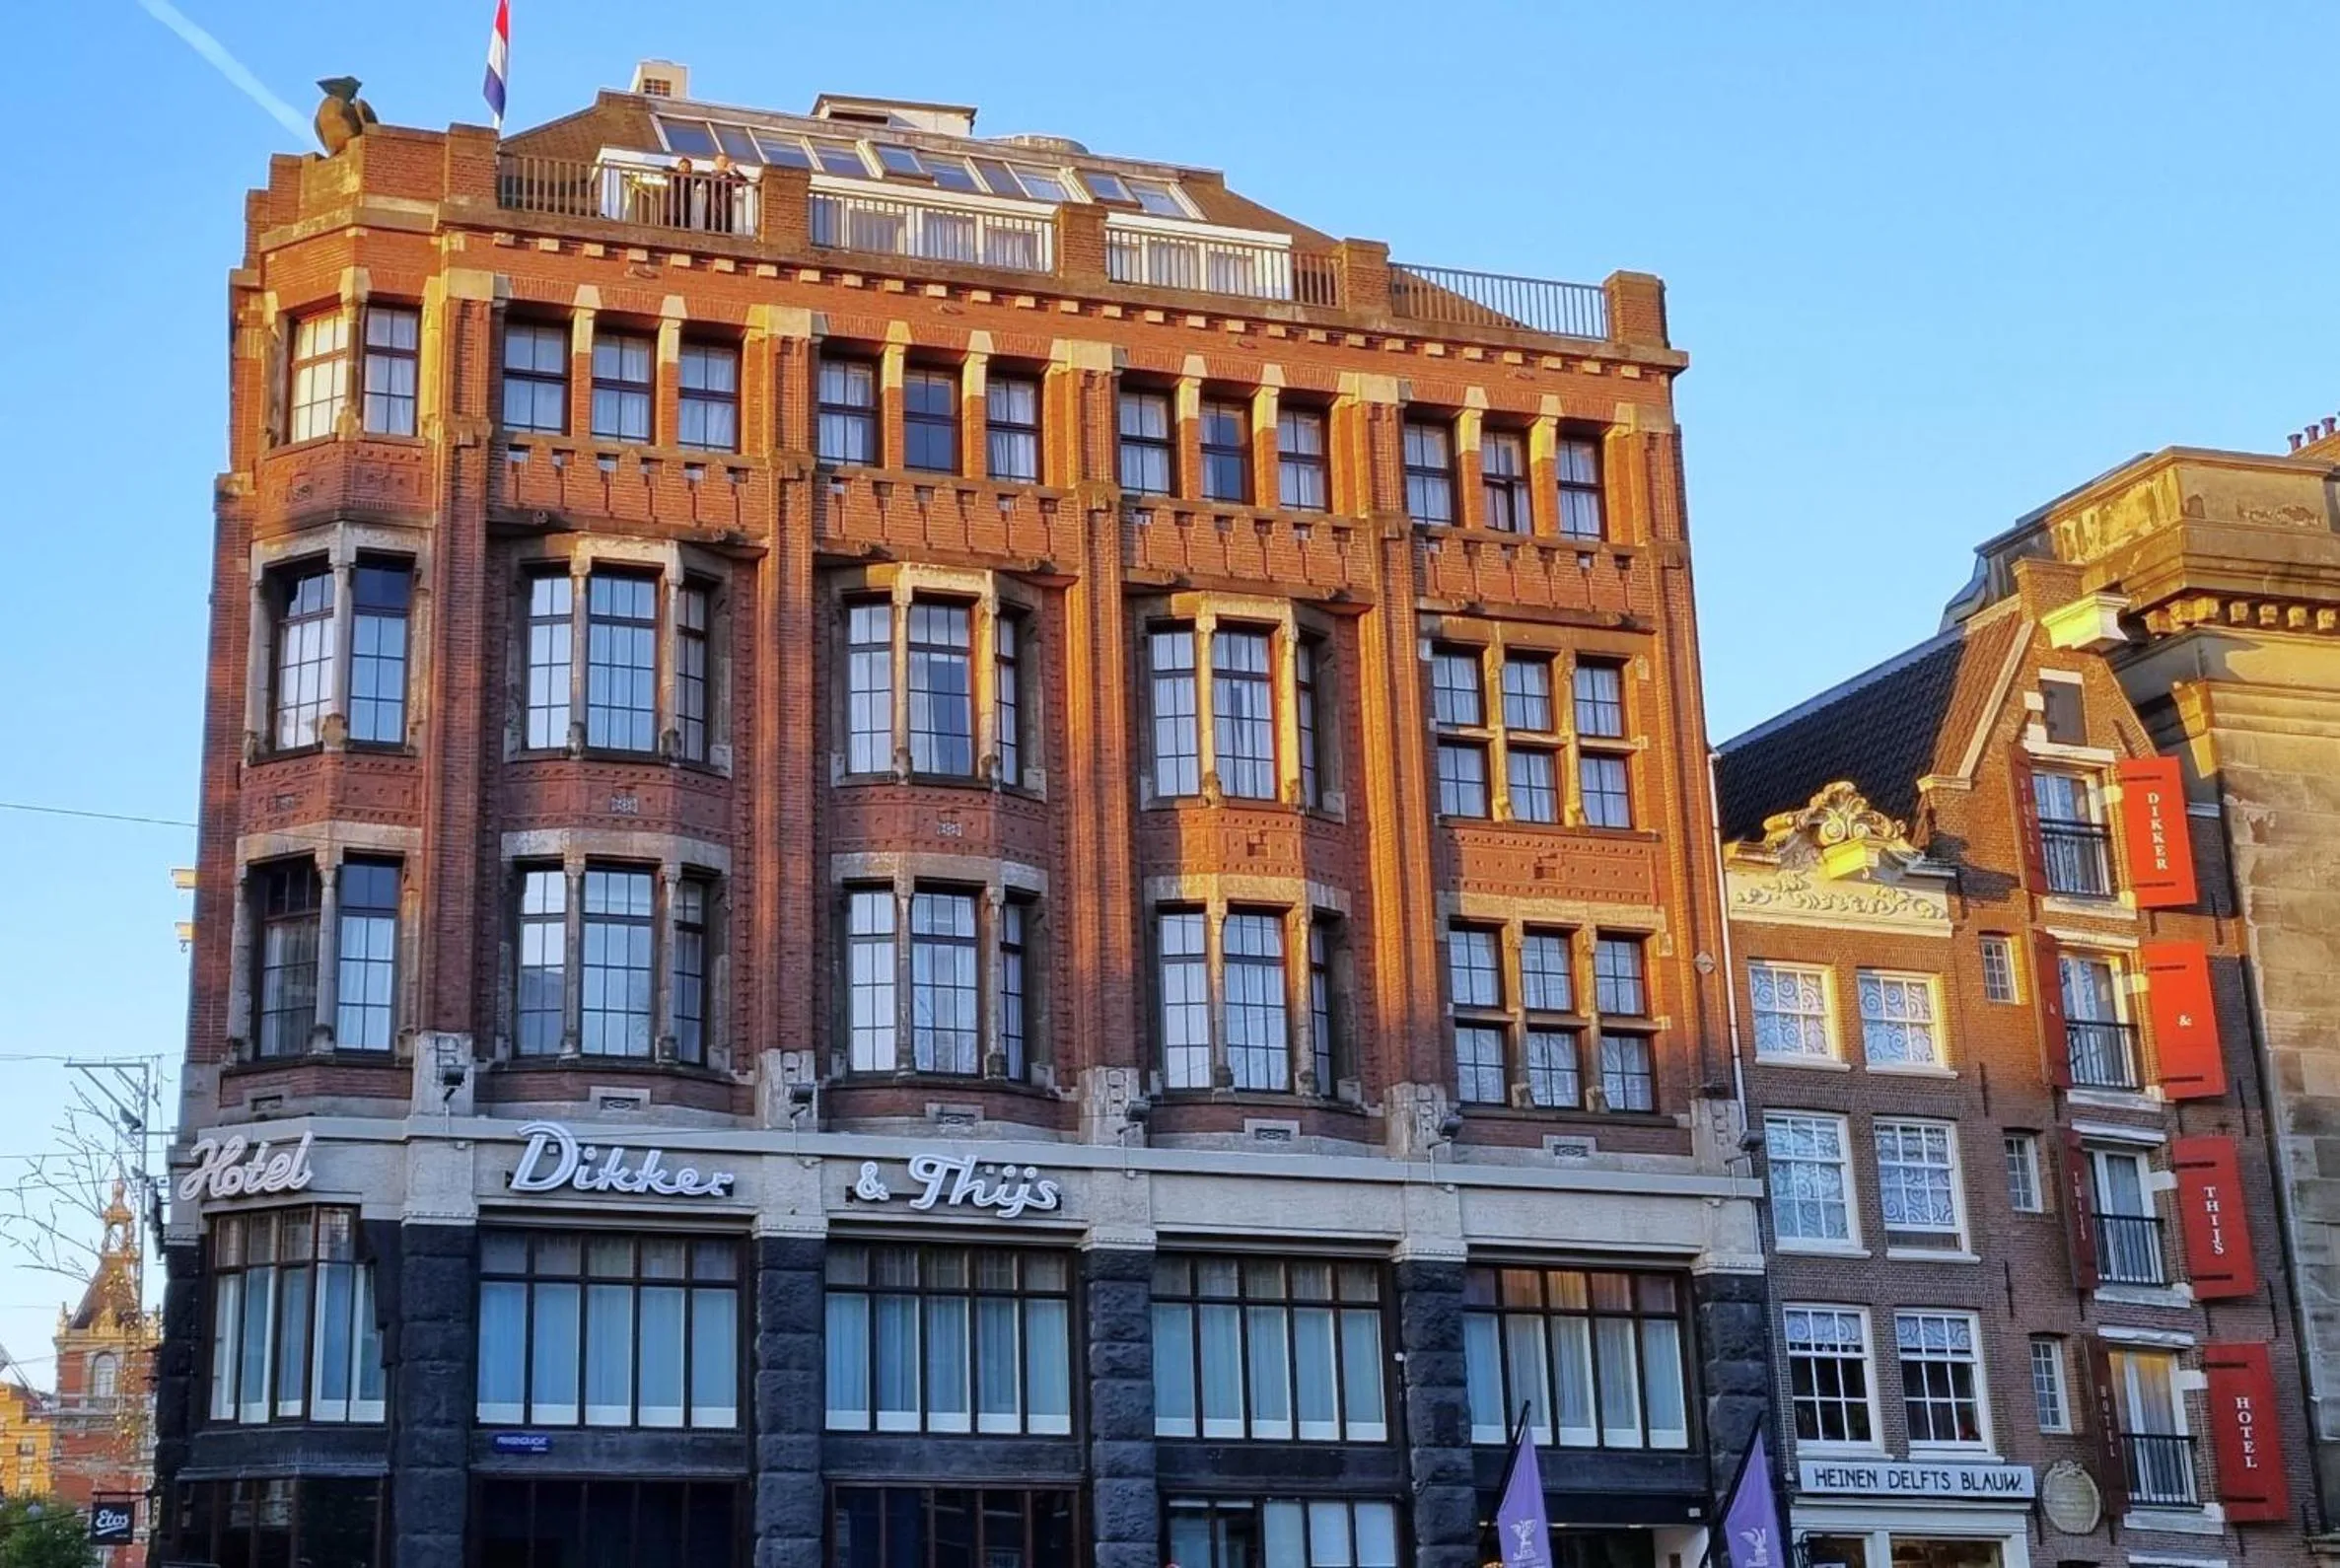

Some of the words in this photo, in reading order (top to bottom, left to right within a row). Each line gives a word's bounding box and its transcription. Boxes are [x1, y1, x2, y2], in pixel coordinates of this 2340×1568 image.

[2147, 792, 2167, 870] DIKKER
[2177, 1015, 2192, 1027] &
[177, 1130, 314, 1201] Hotel
[509, 1120, 734, 1196] Dikker
[856, 1161, 889, 1200] &
[908, 1154, 1059, 1218] Thijs
[2203, 1186, 2224, 1254] THIJS
[2235, 1396, 2257, 1468] HOTEL
[1814, 1467, 1878, 1488] HEINEN
[1887, 1470, 1950, 1490] DELFTS
[96, 1509, 129, 1529] Etos
